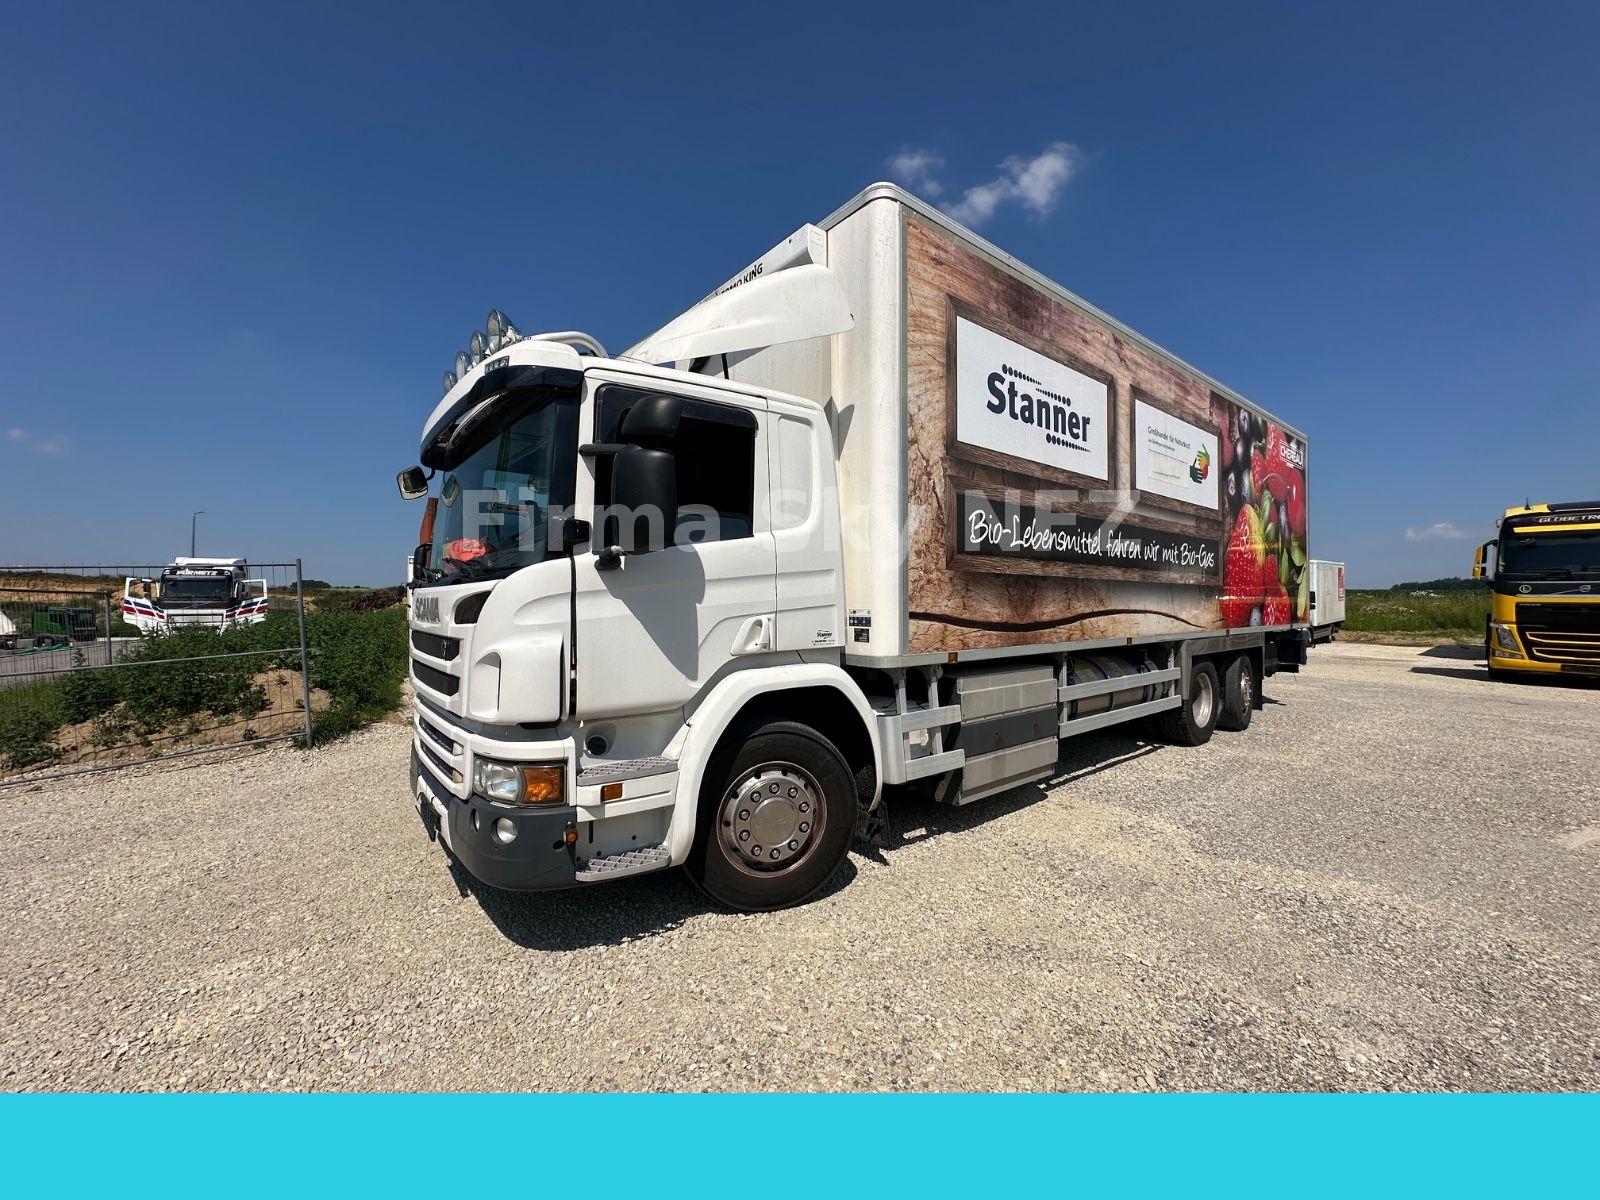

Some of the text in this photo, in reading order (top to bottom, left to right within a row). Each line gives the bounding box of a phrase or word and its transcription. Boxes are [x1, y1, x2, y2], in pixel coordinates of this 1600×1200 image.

[743, 262, 763, 284] KING
[986, 370, 1091, 443] Stanner
[968, 509, 1215, 568] Bio-Lebensmittel fahren wir mit Bio-Gas
[415, 597, 441, 623] SCANIA
